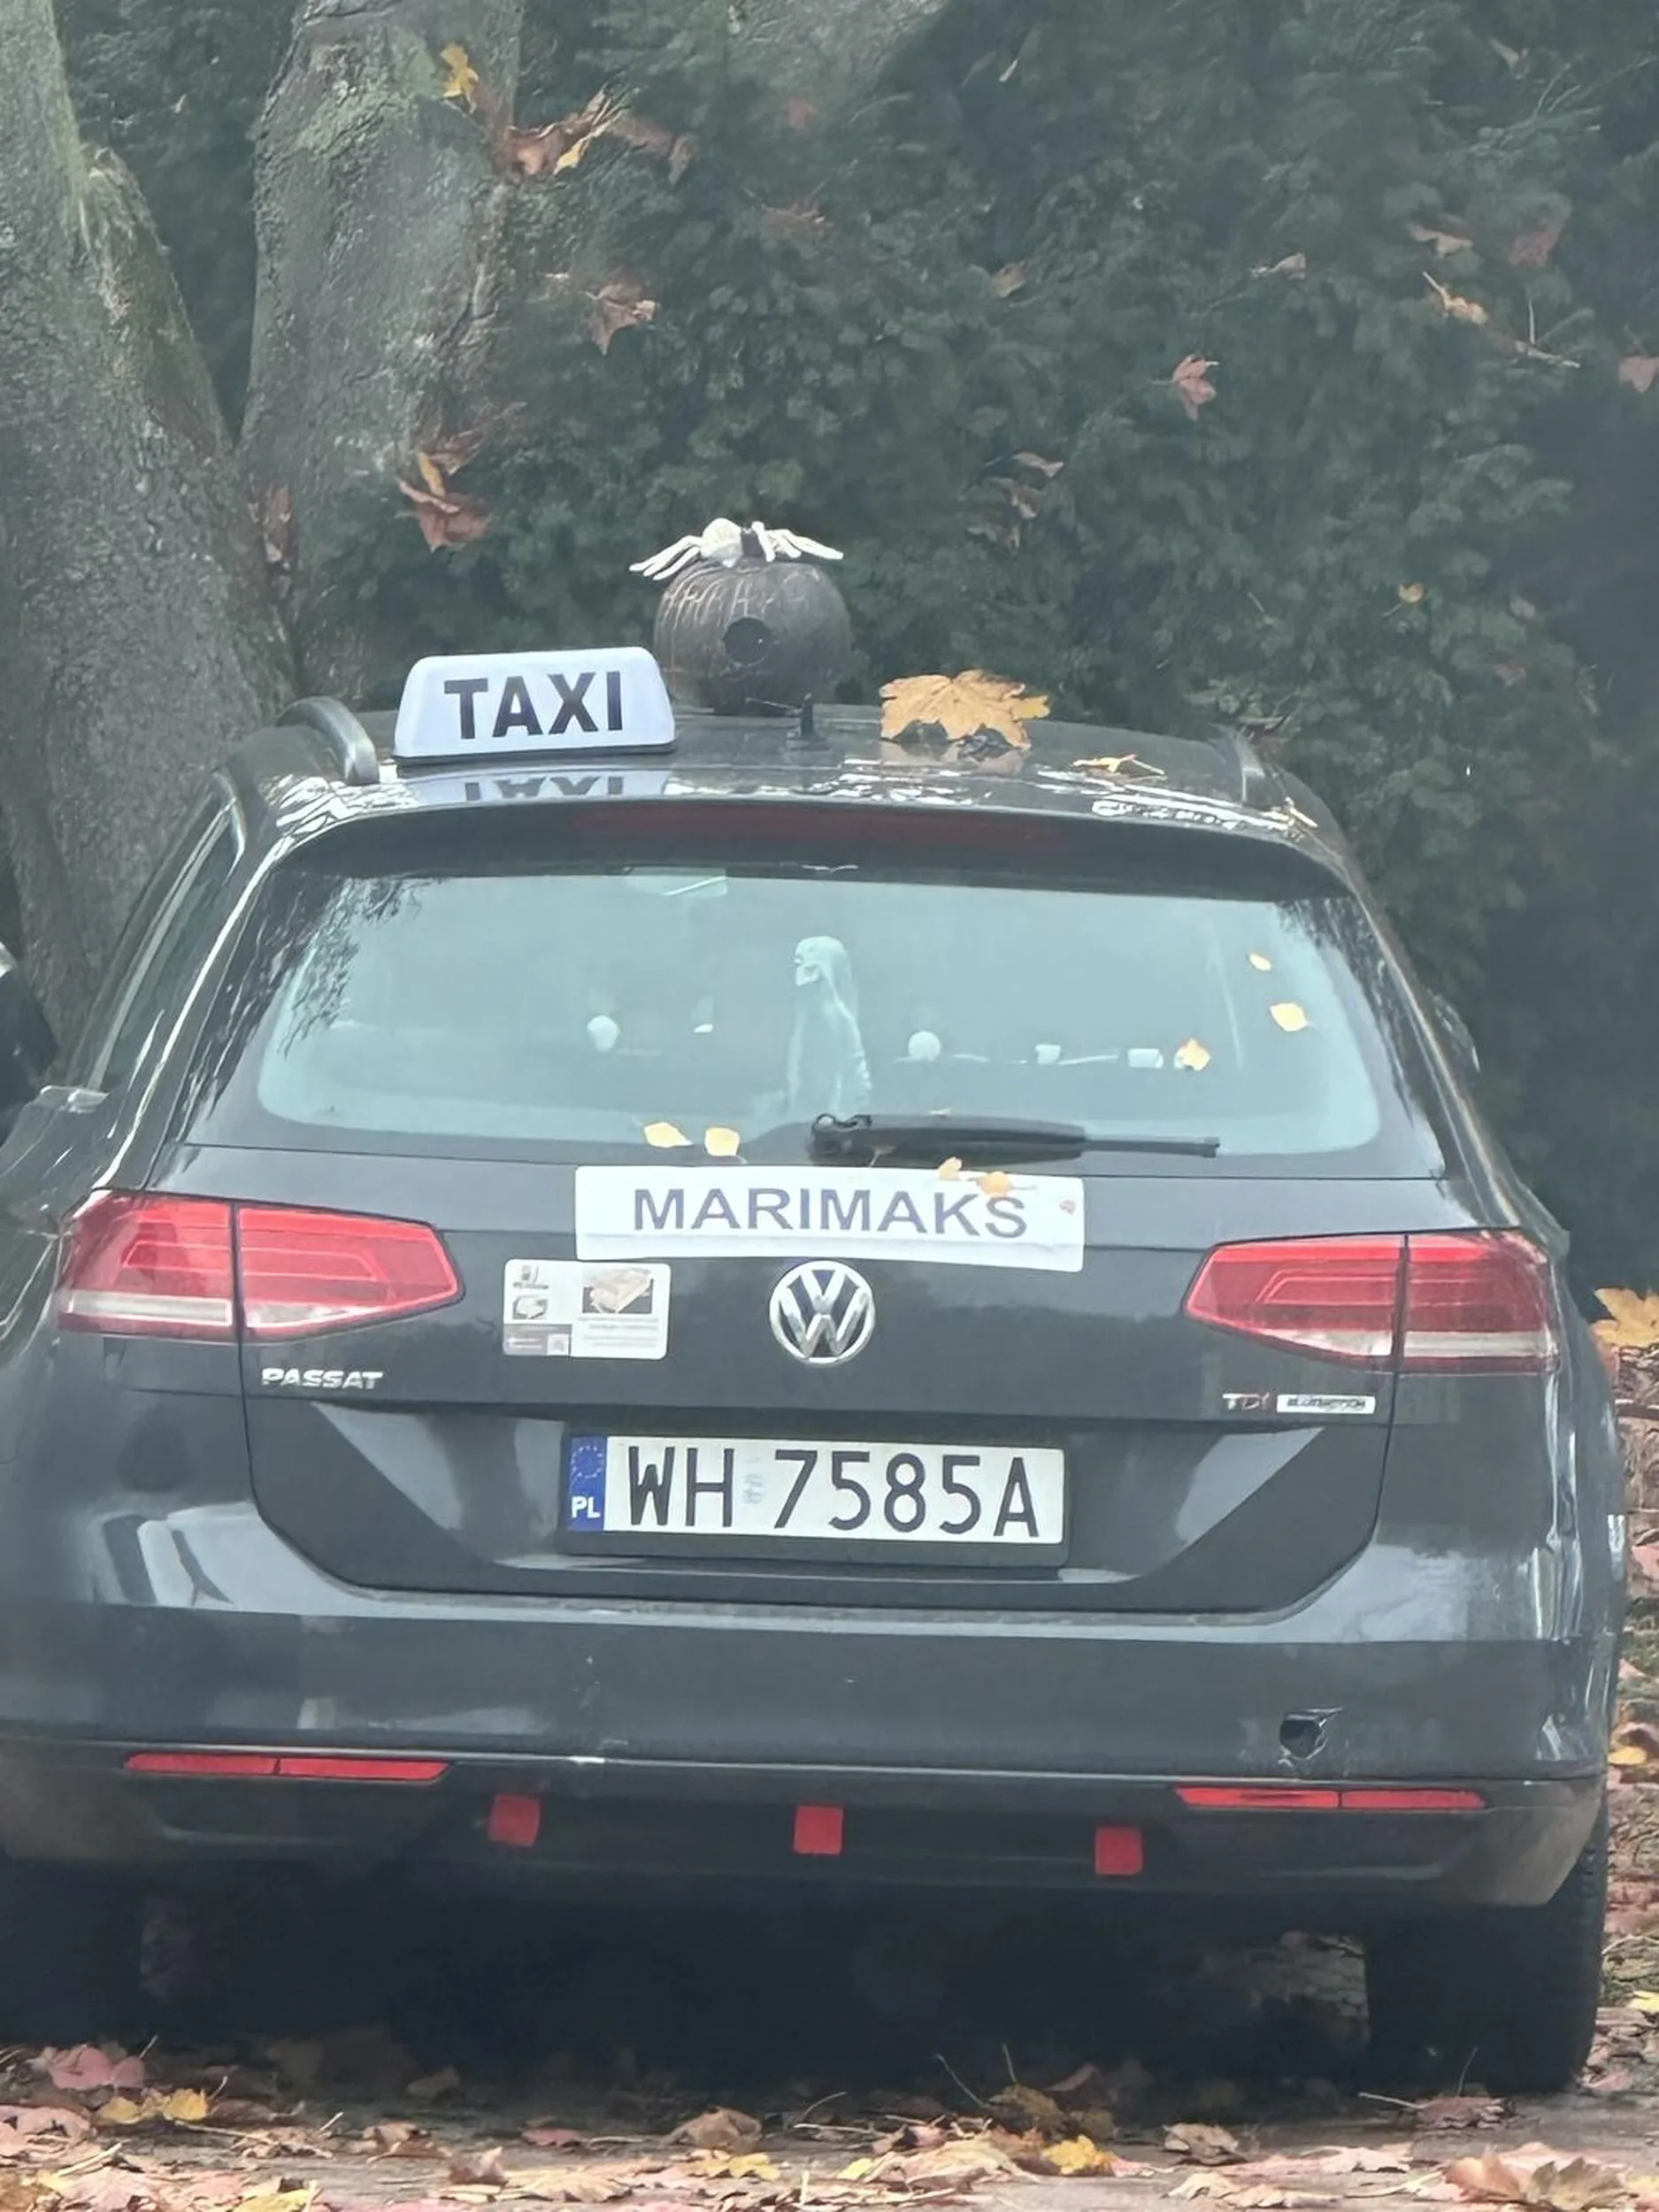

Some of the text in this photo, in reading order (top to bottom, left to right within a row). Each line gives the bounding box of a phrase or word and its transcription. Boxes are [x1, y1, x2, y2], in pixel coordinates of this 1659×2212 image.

[443, 670, 624, 741] TAXI
[634, 1187, 1028, 1240] MARIMAKS
[769, 1259, 877, 1365] VW
[262, 1367, 384, 1390] PASSAT
[571, 1497, 601, 1519] PL
[628, 1445, 735, 1528] WH
[773, 1449, 1039, 1538] 7585A
